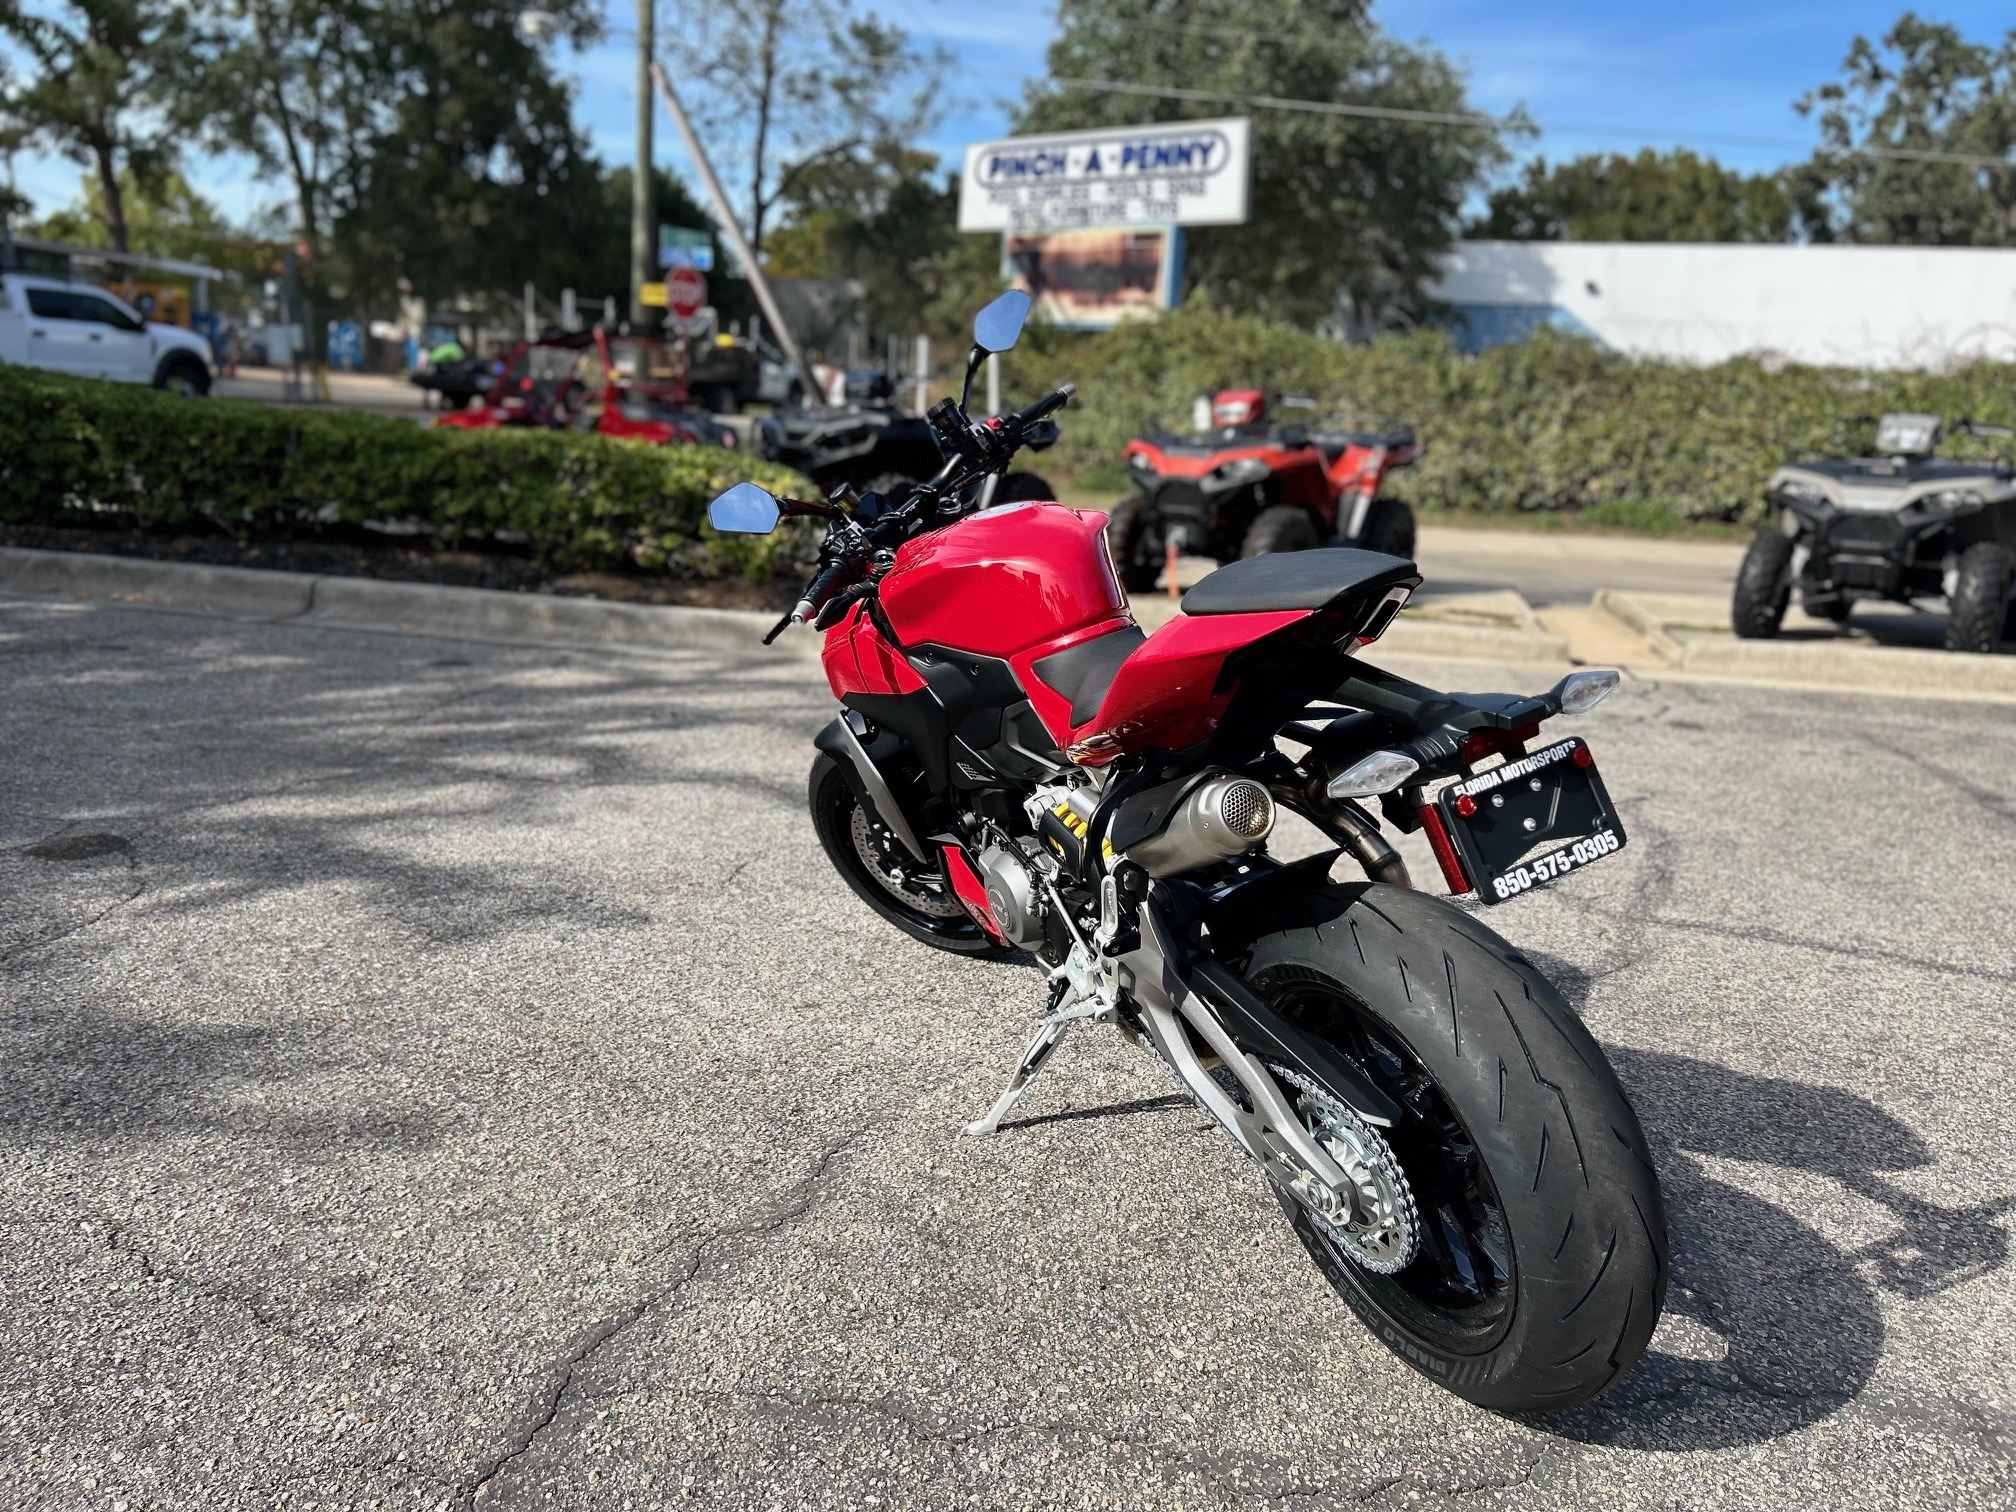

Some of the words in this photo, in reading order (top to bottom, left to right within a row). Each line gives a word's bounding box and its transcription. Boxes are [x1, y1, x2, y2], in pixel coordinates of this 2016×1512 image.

[989, 151, 1068, 178] PINCH
[1083, 148, 1102, 173] A
[1121, 140, 1215, 172] PENNY
[1452, 770, 1503, 797] FLORIDA
[1492, 829, 1619, 899] 850-575-0305
[1327, 1265, 1380, 1327] ROSSO
[1383, 1326, 1447, 1374] DIABLO
